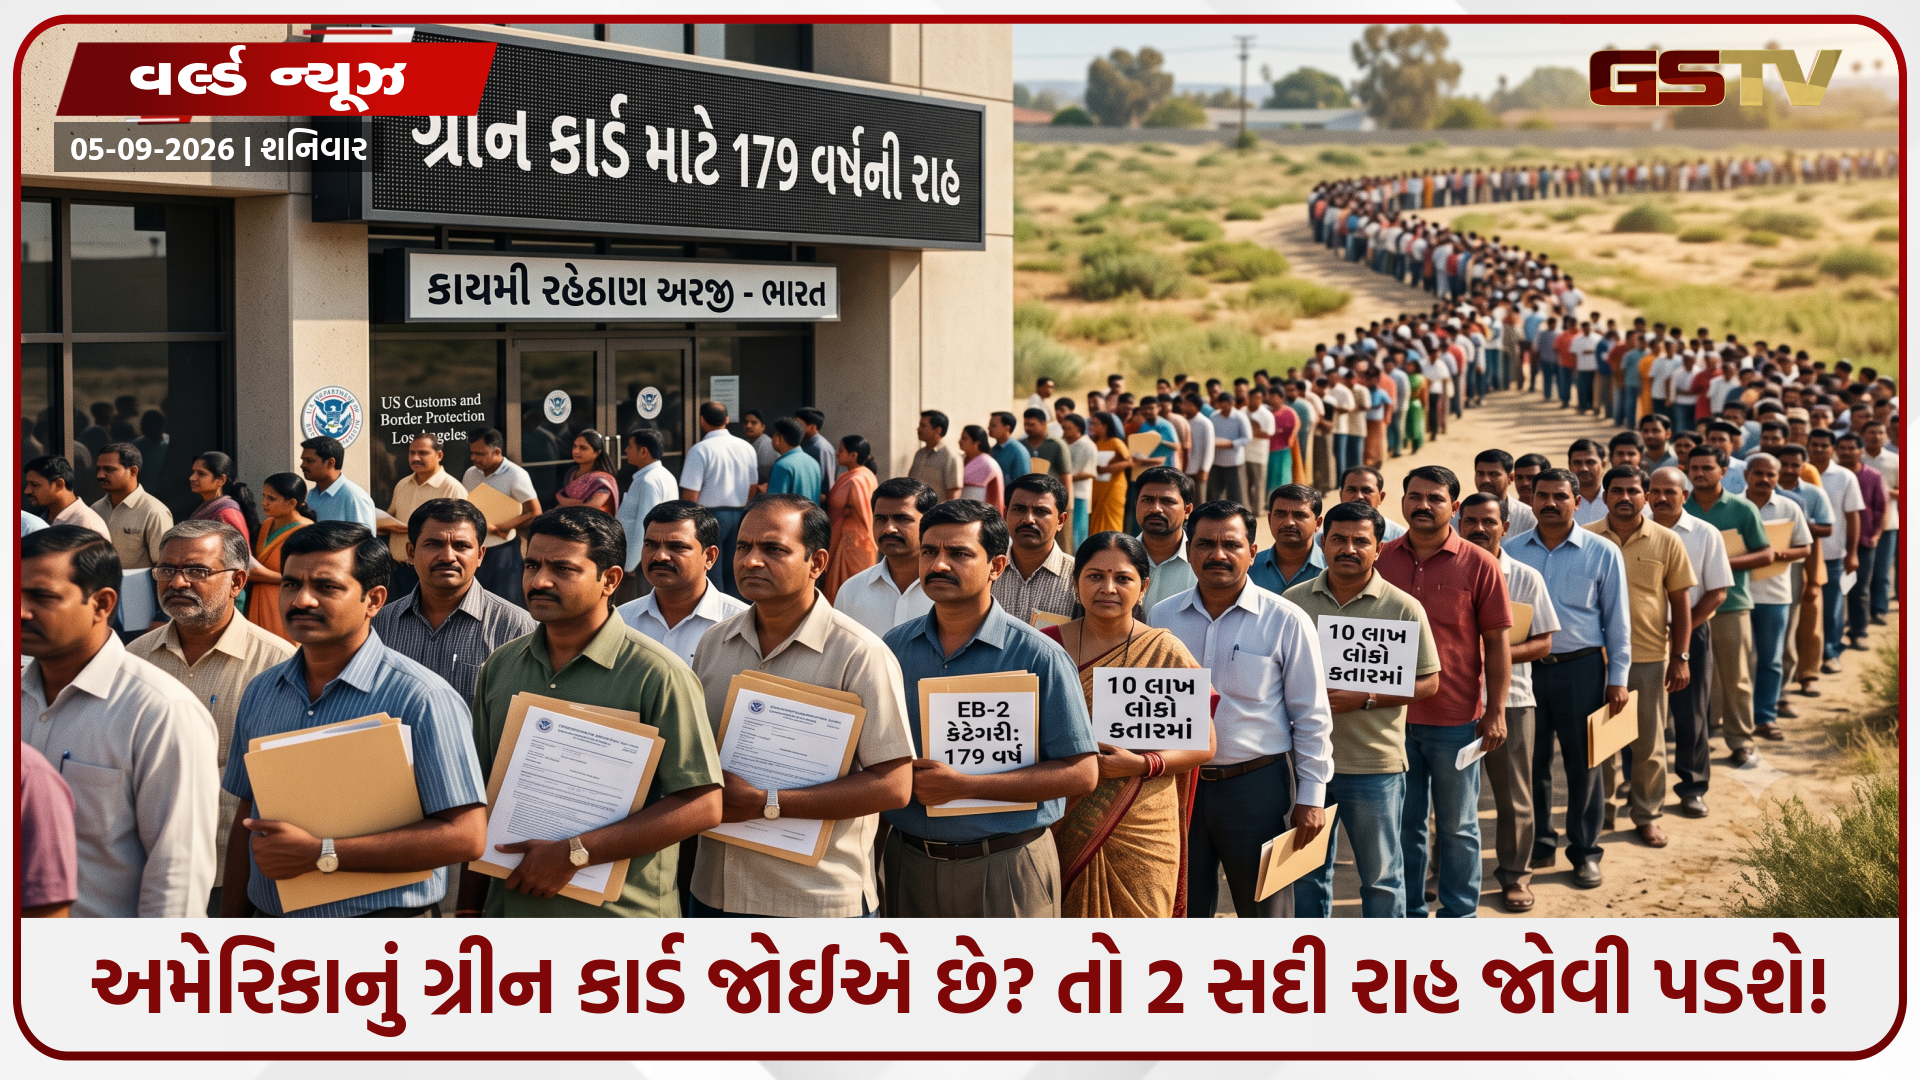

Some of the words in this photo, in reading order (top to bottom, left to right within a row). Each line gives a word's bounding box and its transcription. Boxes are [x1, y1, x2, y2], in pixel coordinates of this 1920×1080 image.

[549, 93, 630, 179] કાર્ડ
[645, 104, 720, 186] માટે
[732, 133, 799, 192] 179
[811, 125, 903, 201] વર્ષની
[911, 154, 961, 206] રાહ
[427, 261, 531, 306] કાયમી
[542, 263, 647, 306] રહેઠાણ
[657, 277, 735, 314] અરજી
[762, 279, 826, 307] ભારત
[381, 396, 401, 410] US
[404, 395, 457, 409] Customs
[459, 392, 482, 406] and
[380, 412, 423, 426] Border
[425, 410, 486, 424] Protection
[391, 431, 415, 445] Los
[421, 428, 467, 445] geles
[1329, 624, 1355, 640] 10
[1362, 627, 1406, 644] લાખ
[1342, 641, 1389, 665] લોકો
[1108, 676, 1137, 695] 10
[1144, 678, 1195, 695] લાખ
[1328, 665, 1403, 685] કતારમાં
[958, 701, 1010, 718] EB-2
[1124, 694, 1176, 718] લોકો
[946, 720, 1019, 742] કેટેગરી:
[1109, 717, 1192, 739] કતારમાં
[944, 748, 985, 765] 179
[991, 743, 1023, 765] વર્ષ
